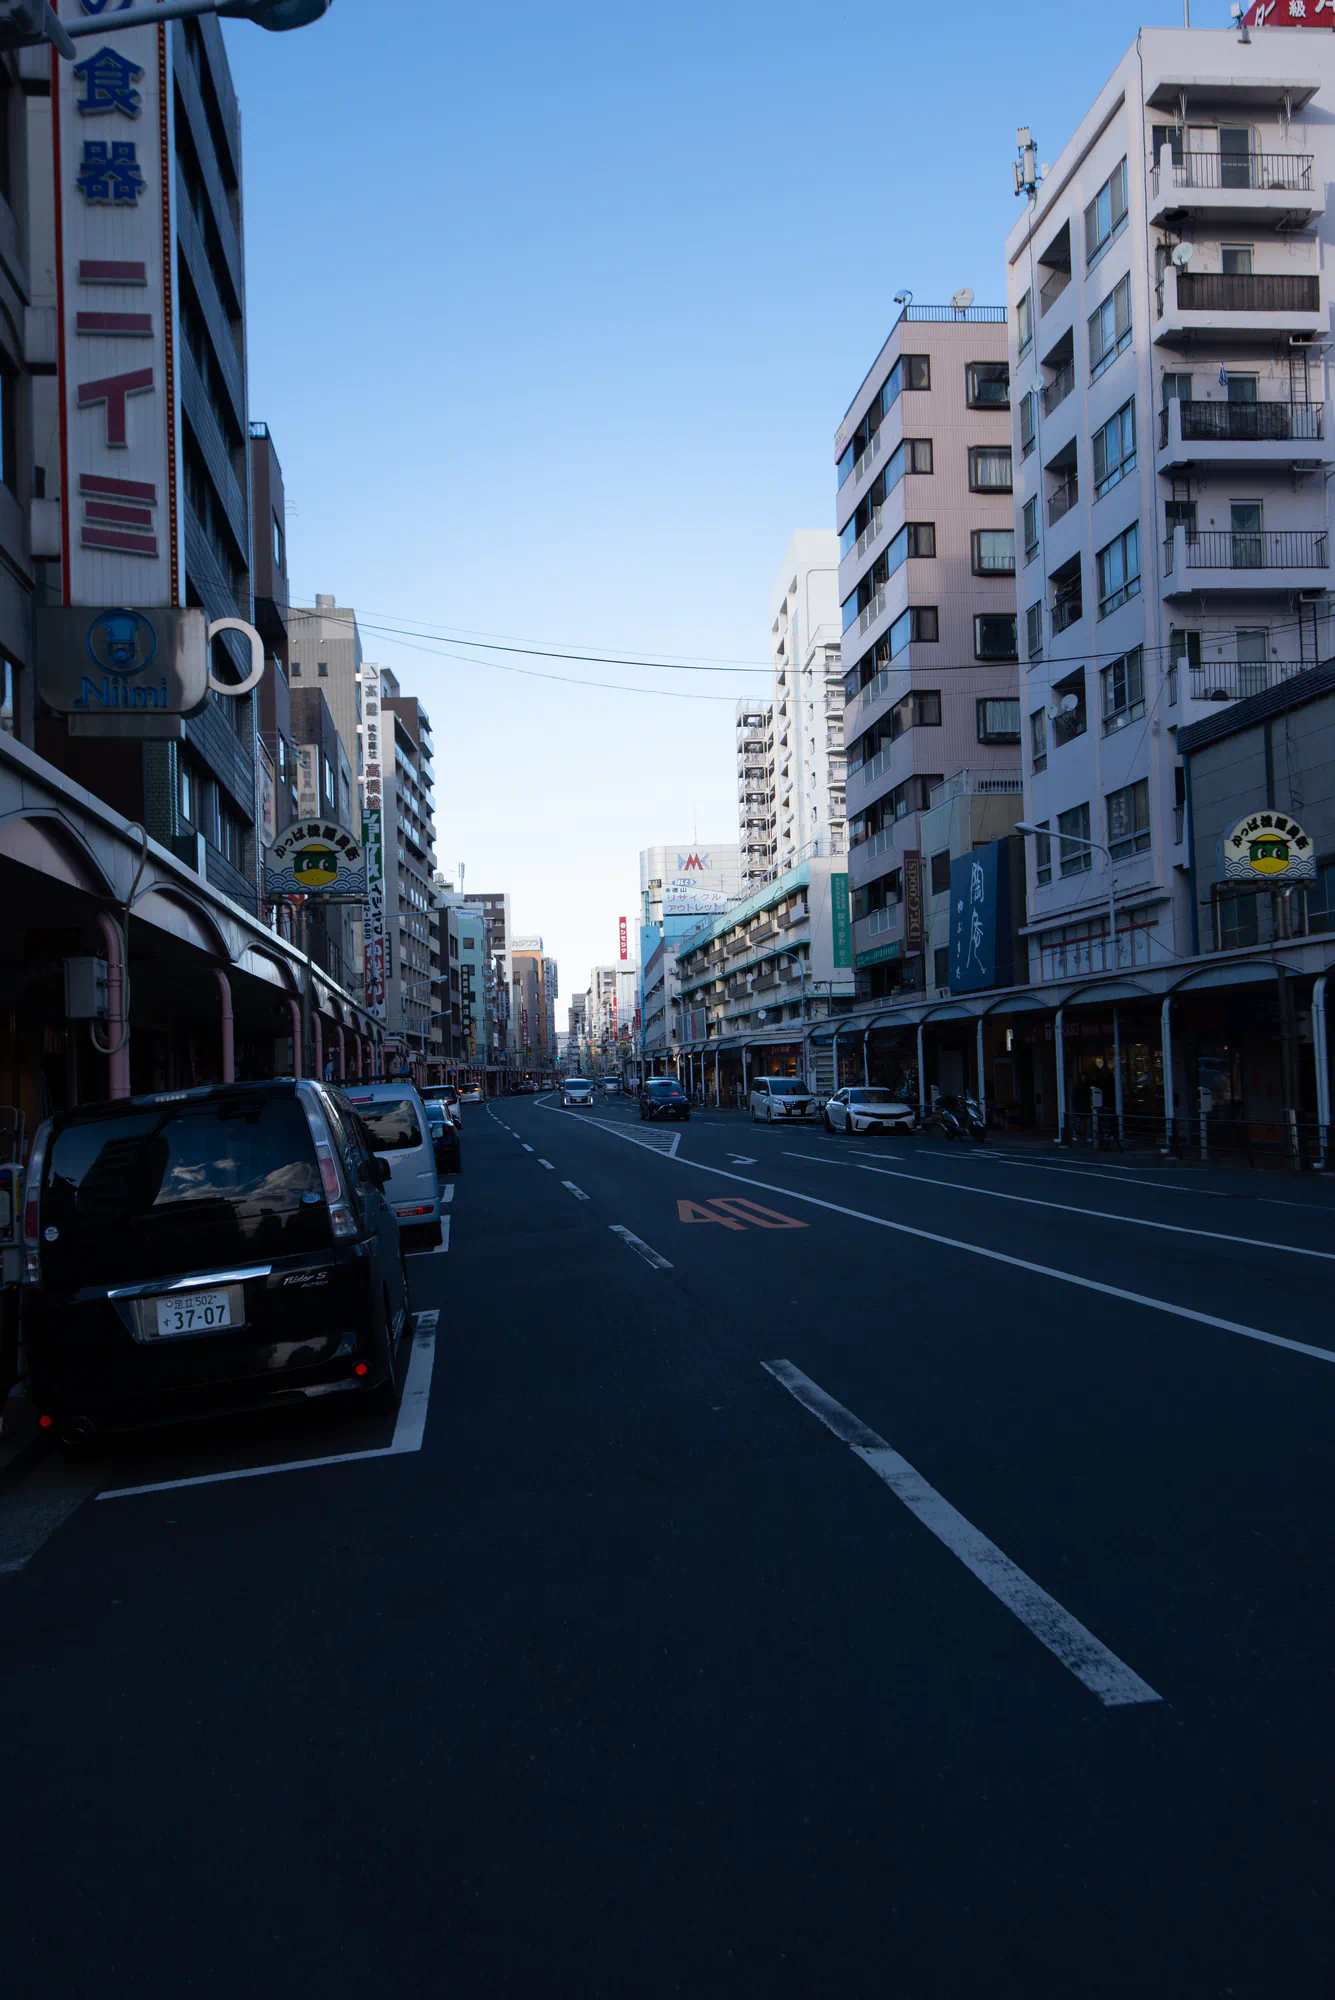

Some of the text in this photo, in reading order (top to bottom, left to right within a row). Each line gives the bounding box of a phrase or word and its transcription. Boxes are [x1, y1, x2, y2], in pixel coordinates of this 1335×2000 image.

[76, 258, 159, 558] ニイミ
[73, 675, 168, 710] Niimi
[667, 893, 721, 903] リサイクル
[667, 902, 720, 913] アウトレット
[676, 1198, 810, 1230] 40
[174, 1295, 213, 1310] 足立 502
[174, 1305, 225, 1329] 37-07
